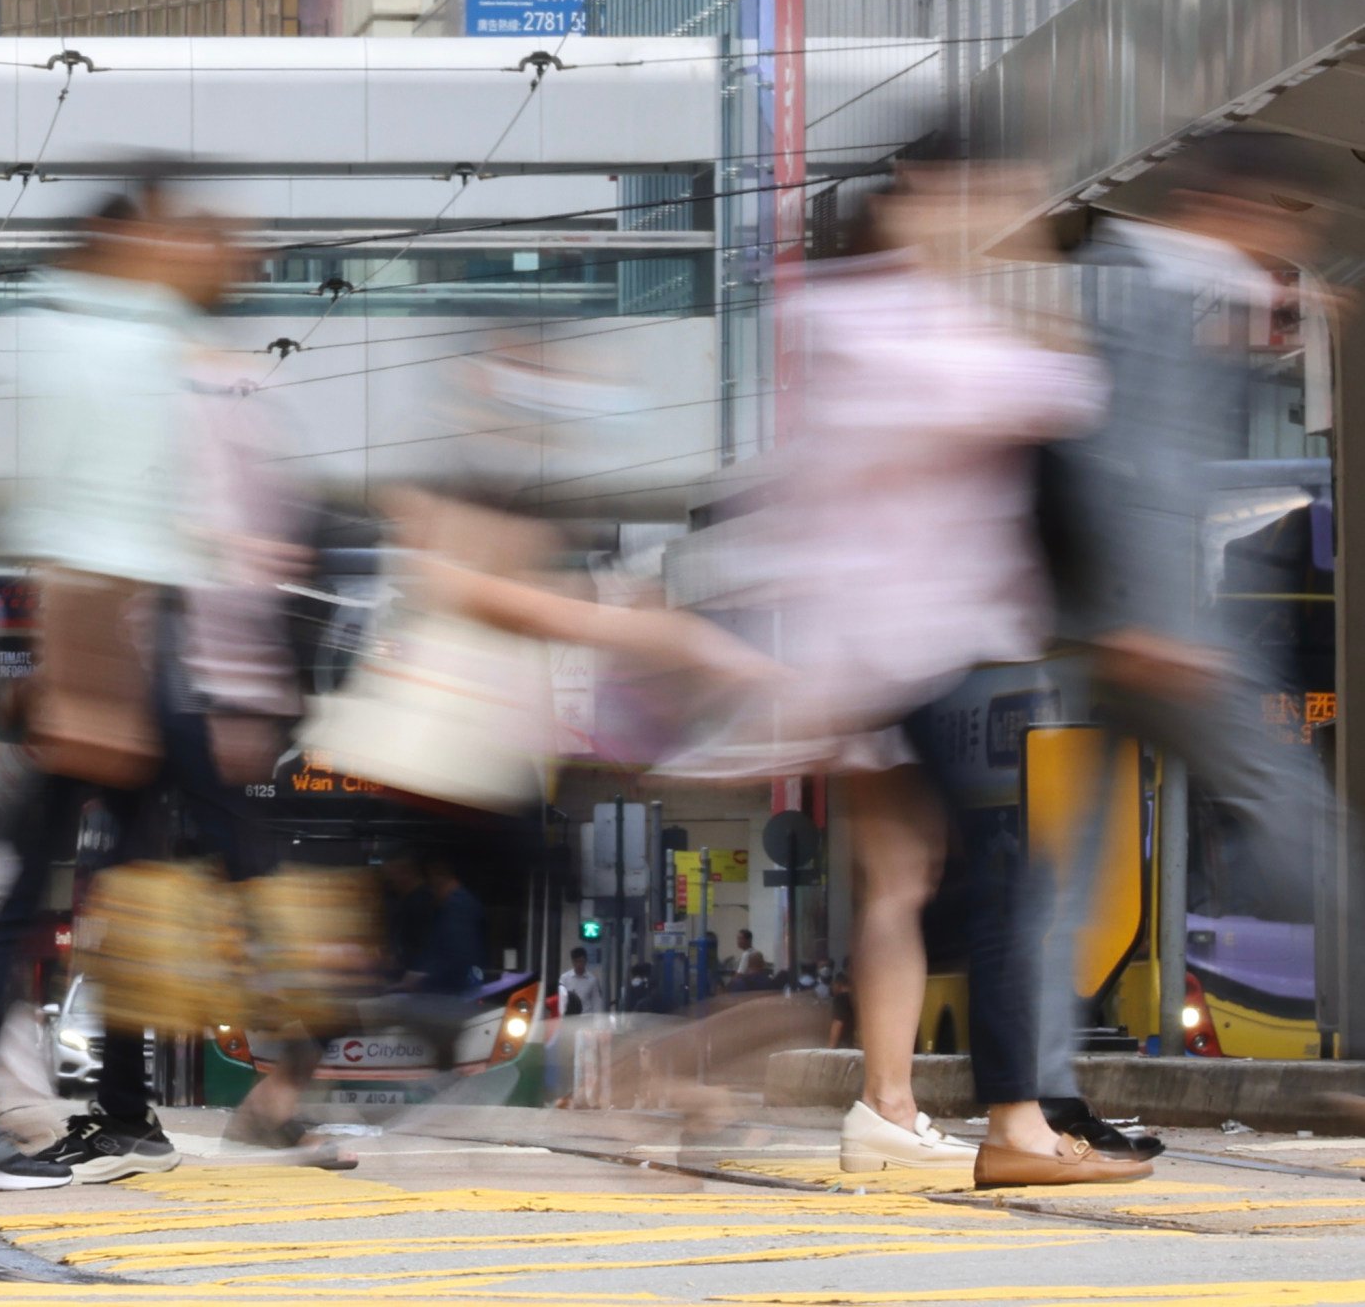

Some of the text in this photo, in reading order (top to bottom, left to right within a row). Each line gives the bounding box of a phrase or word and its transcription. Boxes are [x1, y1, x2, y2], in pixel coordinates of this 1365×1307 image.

[523, 11, 565, 31] 2781
[293, 773, 334, 791] Wan
[245, 784, 276, 798] 6125
[366, 1043, 424, 1058] Citybus
